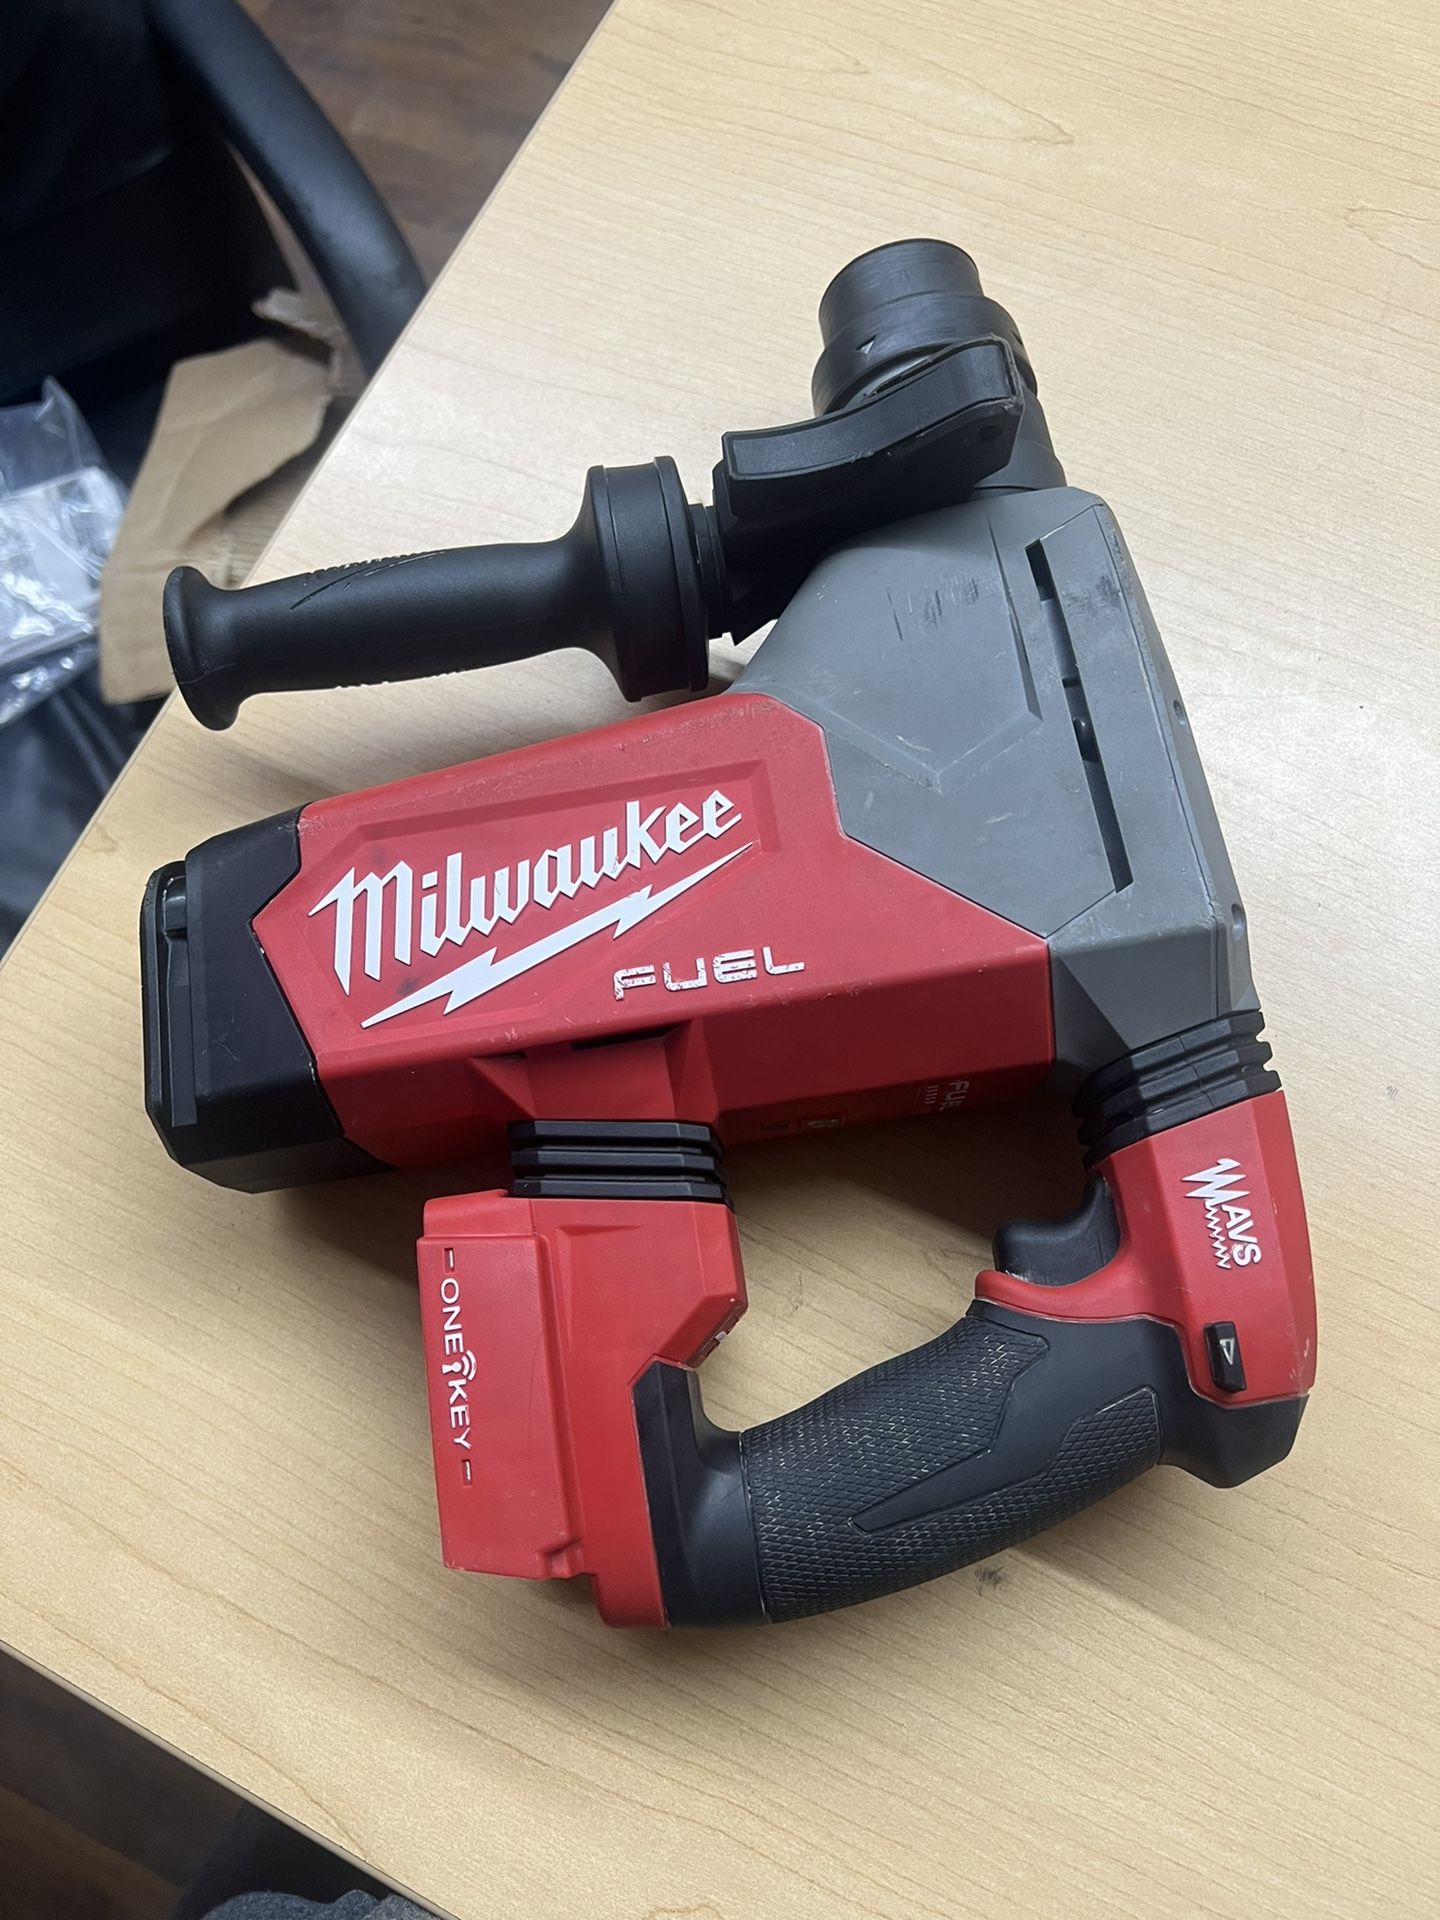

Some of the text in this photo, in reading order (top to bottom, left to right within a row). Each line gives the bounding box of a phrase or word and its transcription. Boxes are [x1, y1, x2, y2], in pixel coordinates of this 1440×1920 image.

[308, 789, 742, 995] Milwaukee
[613, 946, 806, 1001] FUEL
[938, 1080, 971, 1112] FUE
[440, 1277, 473, 1450] ONE KEY
